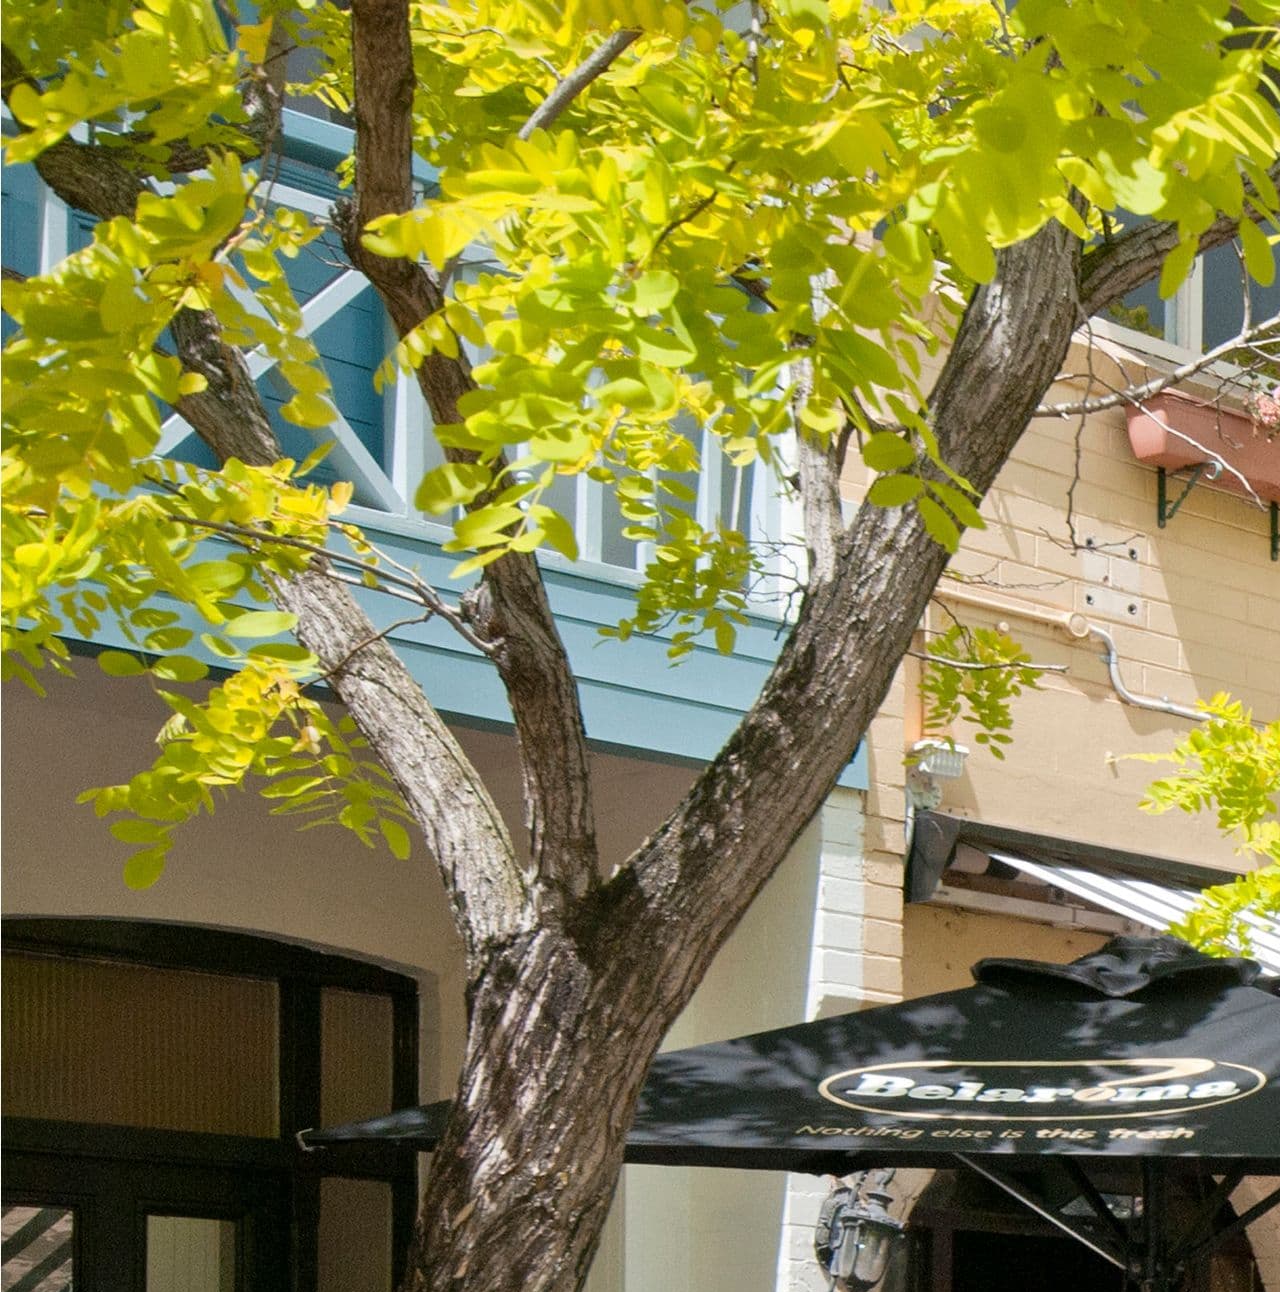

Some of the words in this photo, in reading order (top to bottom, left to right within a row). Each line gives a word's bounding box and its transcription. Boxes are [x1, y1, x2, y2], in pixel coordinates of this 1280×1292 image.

[846, 1073, 1240, 1104] Belaroma
[795, 1124, 924, 1140] Nothing
[931, 1127, 994, 1139] else
[1001, 1126, 1026, 1139] is
[1036, 1127, 1097, 1139] this
[1108, 1127, 1194, 1140] fresh
